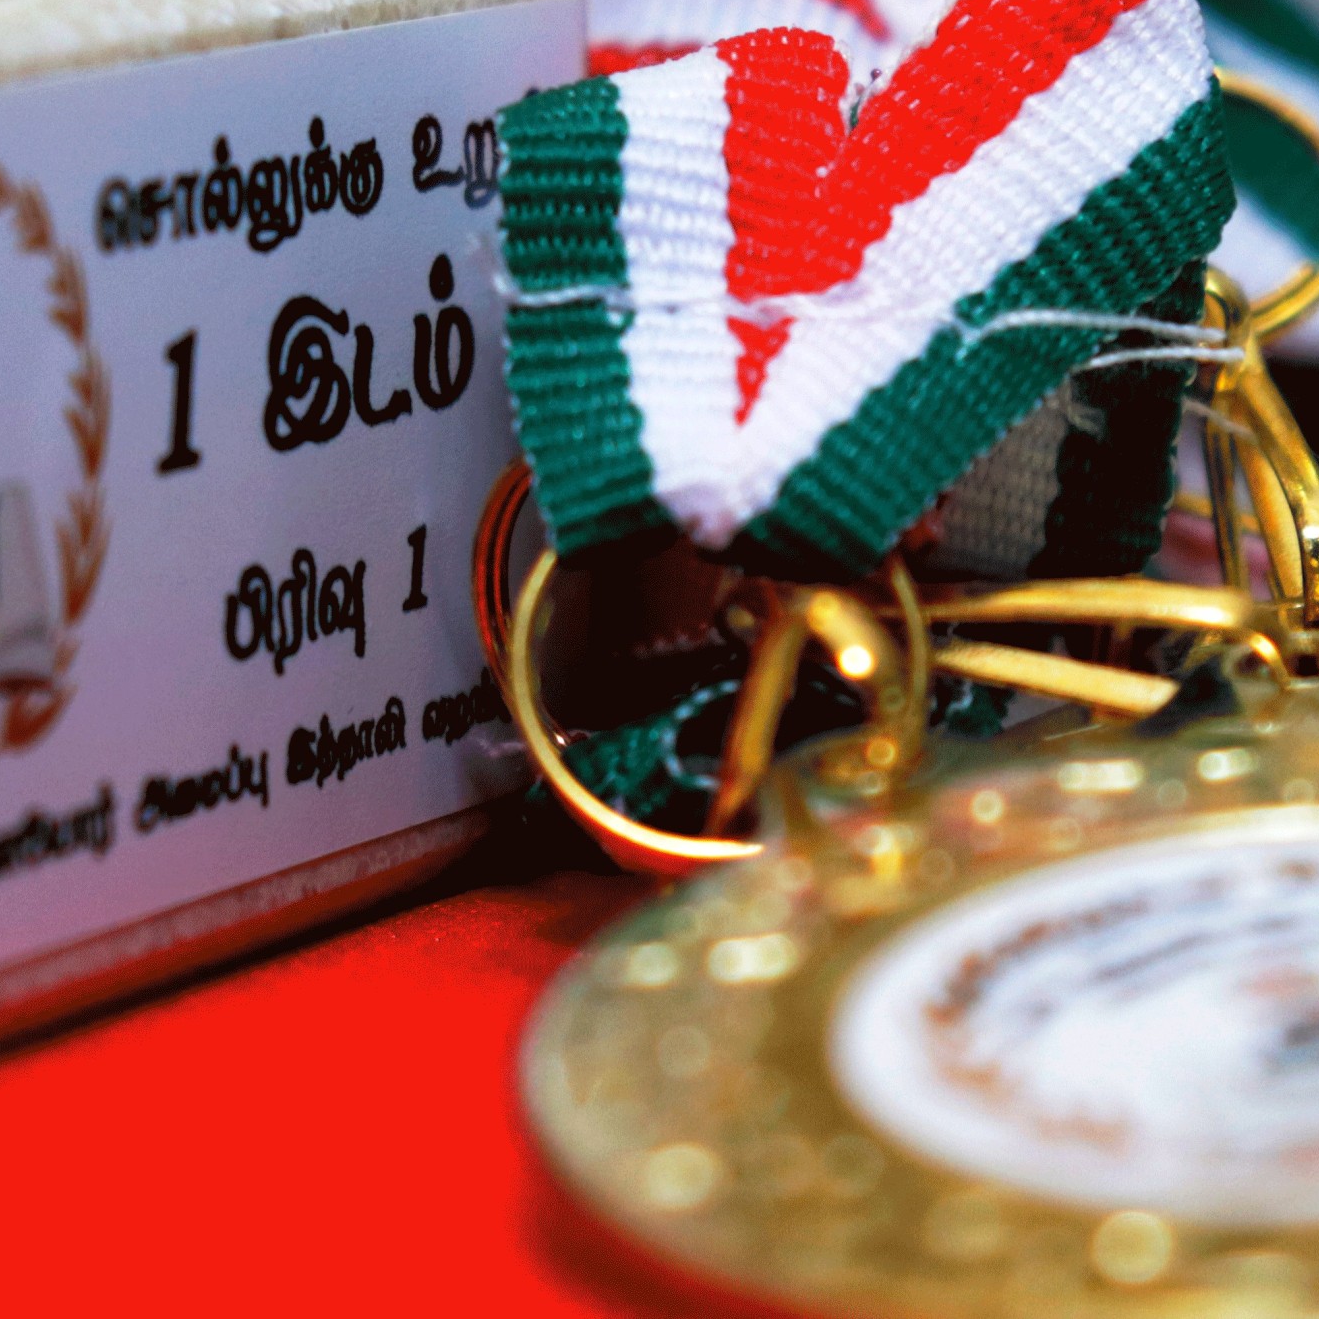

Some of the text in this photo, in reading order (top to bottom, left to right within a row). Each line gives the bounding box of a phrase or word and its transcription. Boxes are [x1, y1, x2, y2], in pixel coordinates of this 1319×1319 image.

[94, 115, 384, 255] சொல்லுக்கு
[157, 254, 475, 476] 1 இடம்
[225, 523, 429, 677] பிரிவு 1
